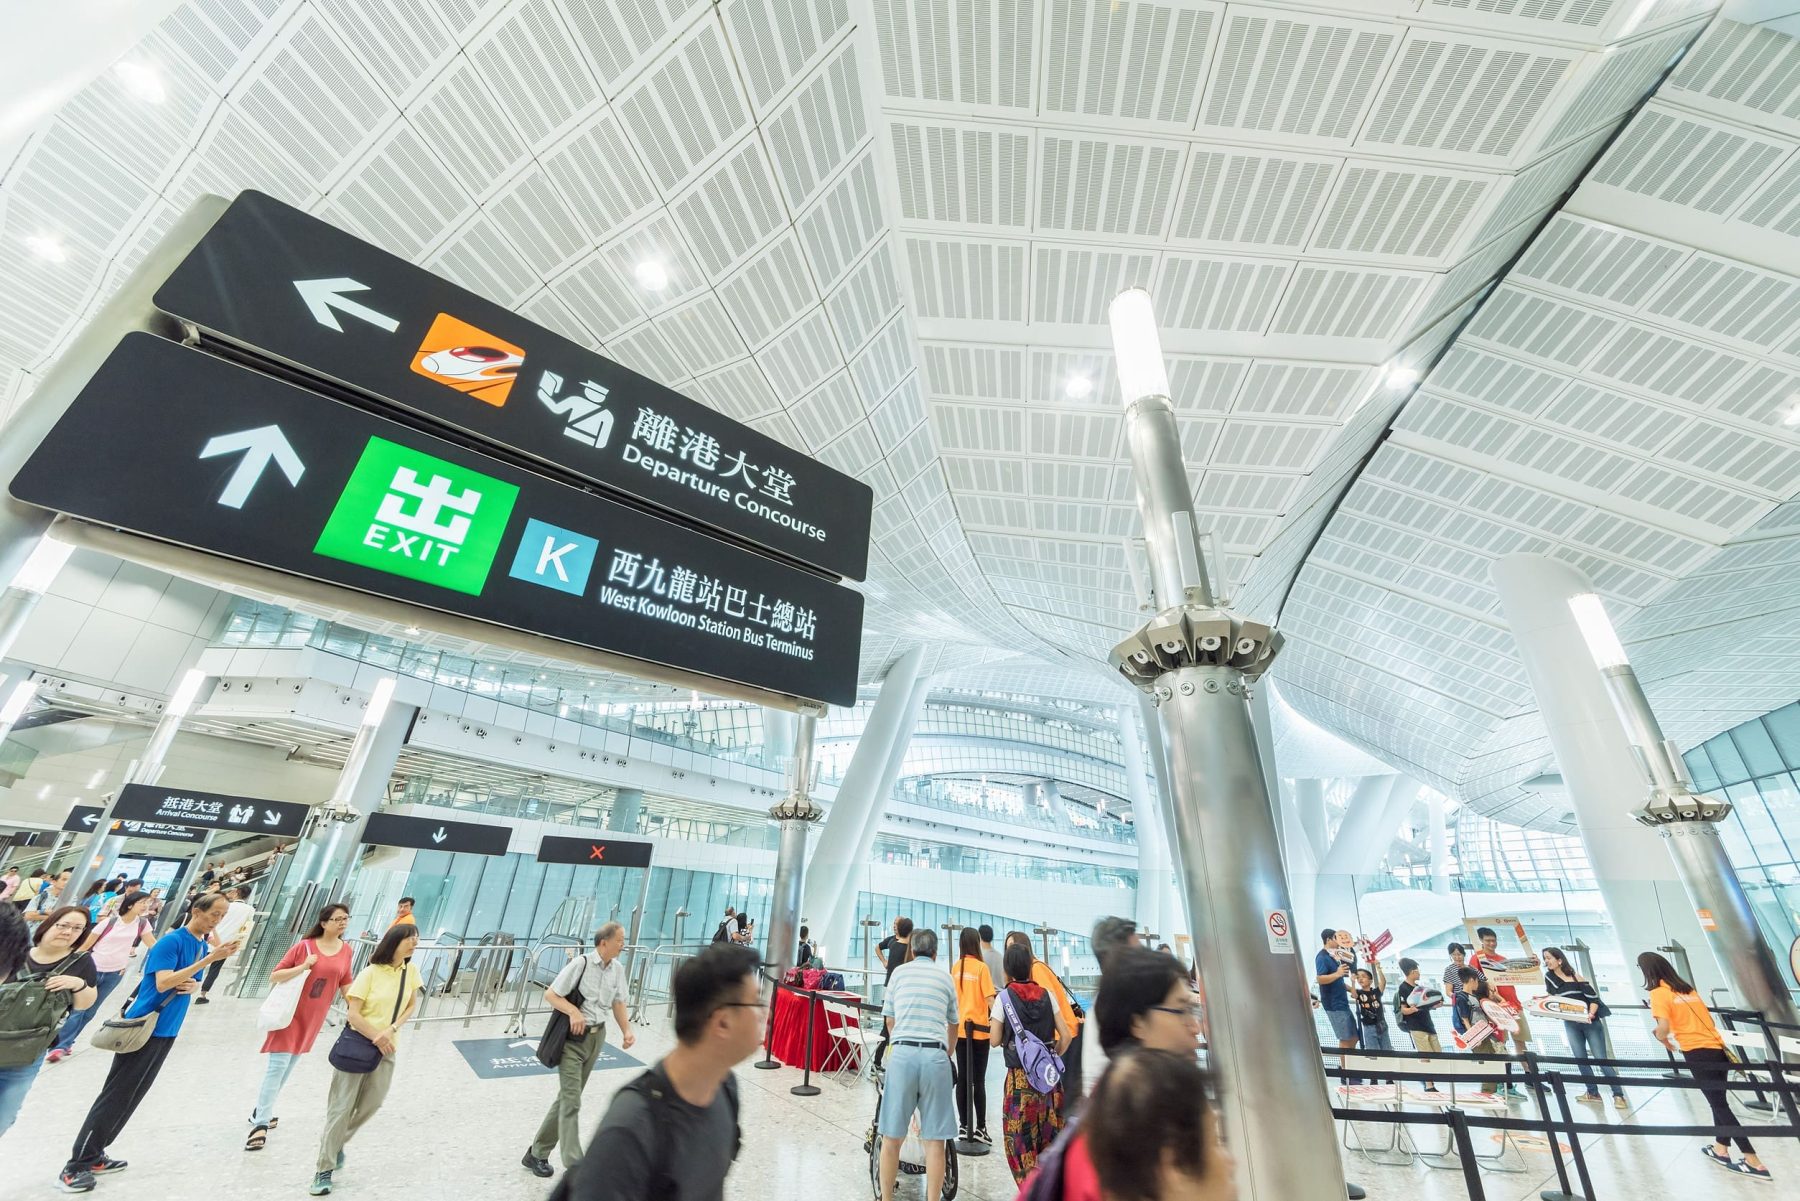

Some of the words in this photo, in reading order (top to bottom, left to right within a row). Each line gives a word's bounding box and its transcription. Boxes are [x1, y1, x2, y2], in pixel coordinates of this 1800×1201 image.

[632, 406, 797, 506] 離港大堂
[622, 443, 731, 503] Departure
[734, 492, 827, 542] Concourse
[362, 523, 460, 567] EXIT
[535, 535, 578, 583] K
[608, 548, 817, 641] 西九龍站巴士總站
[600, 585, 635, 612] West
[637, 597, 696, 629] Kowloon
[697, 614, 742, 641] Station
[743, 626, 764, 648] Bus
[765, 633, 815, 661] Terminus
[155, 808, 180, 818] Arrival
[180, 811, 218, 822] Concourse
[162, 796, 224, 815] 抵港大堂
[140, 827, 168, 836] Departure
